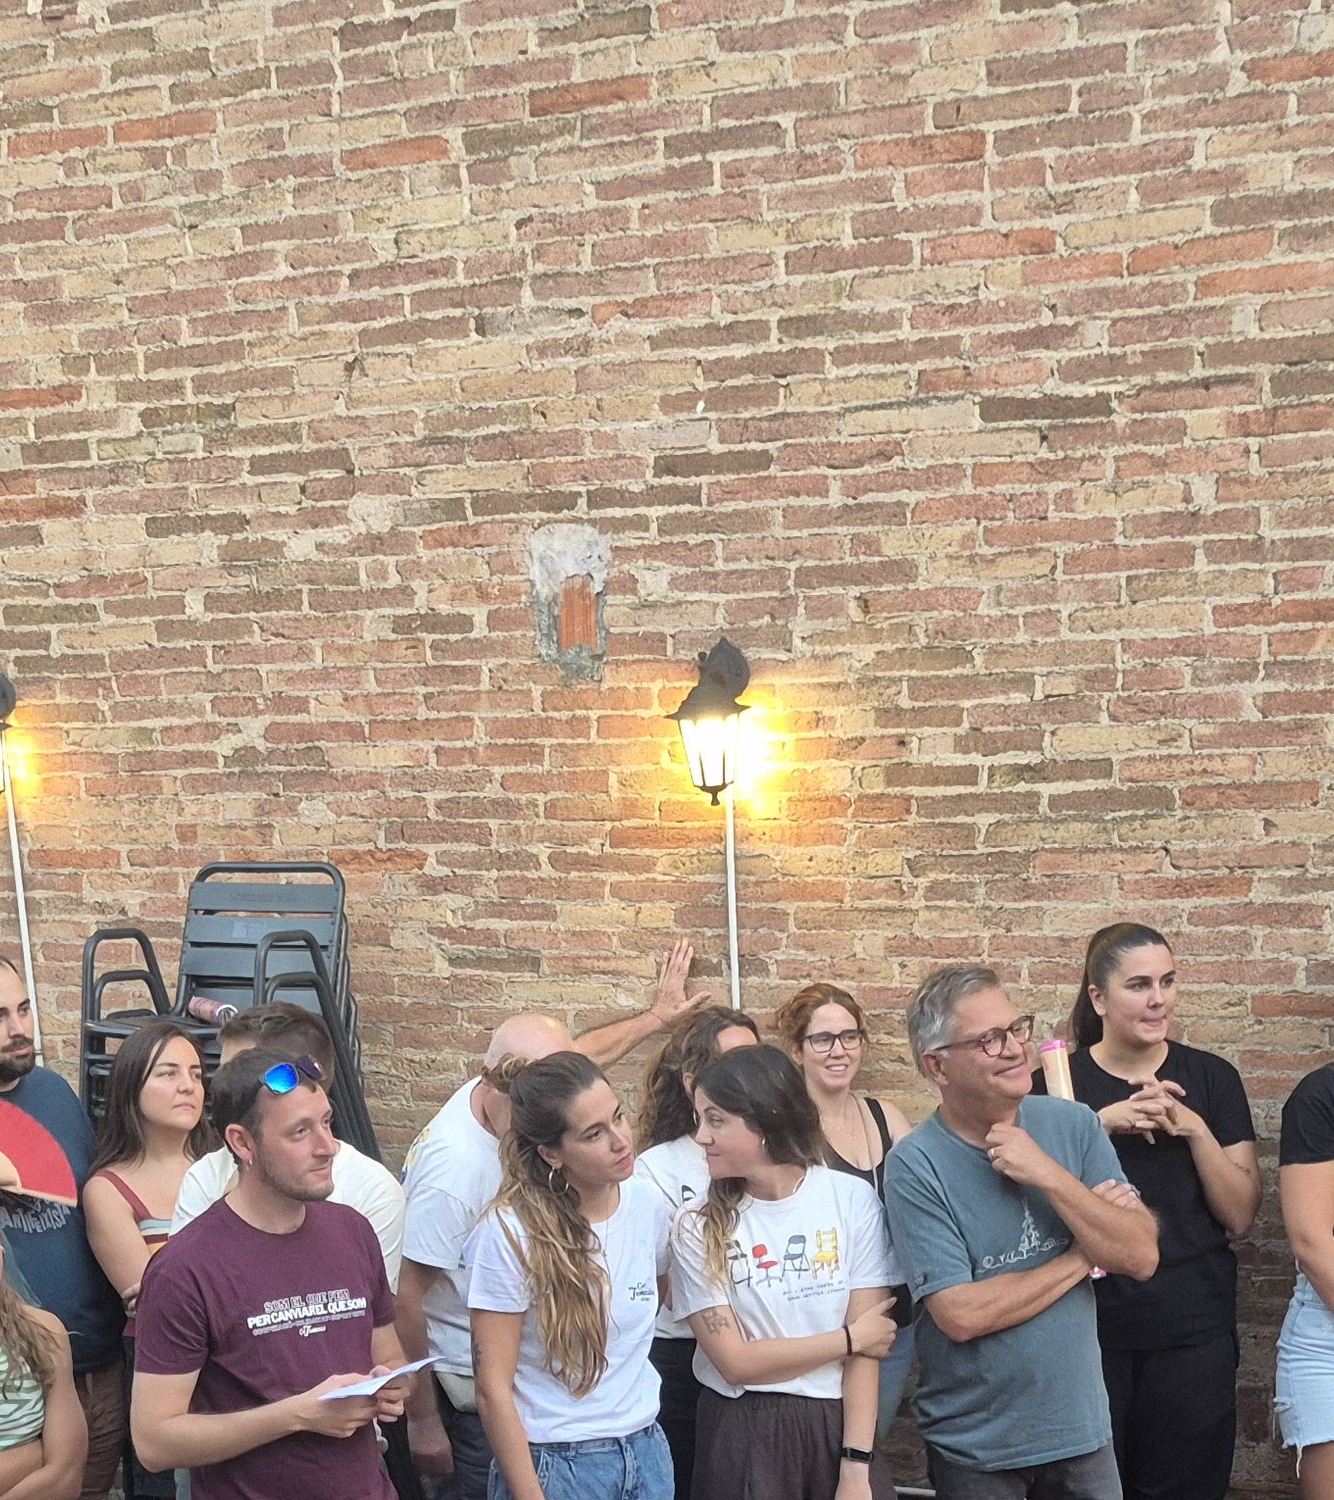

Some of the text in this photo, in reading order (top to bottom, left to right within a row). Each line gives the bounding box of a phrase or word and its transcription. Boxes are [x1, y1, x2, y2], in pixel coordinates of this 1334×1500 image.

[247, 1314, 271, 1329] PER
[327, 1300, 347, 1314] QUE
[347, 1296, 367, 1310] SOM
